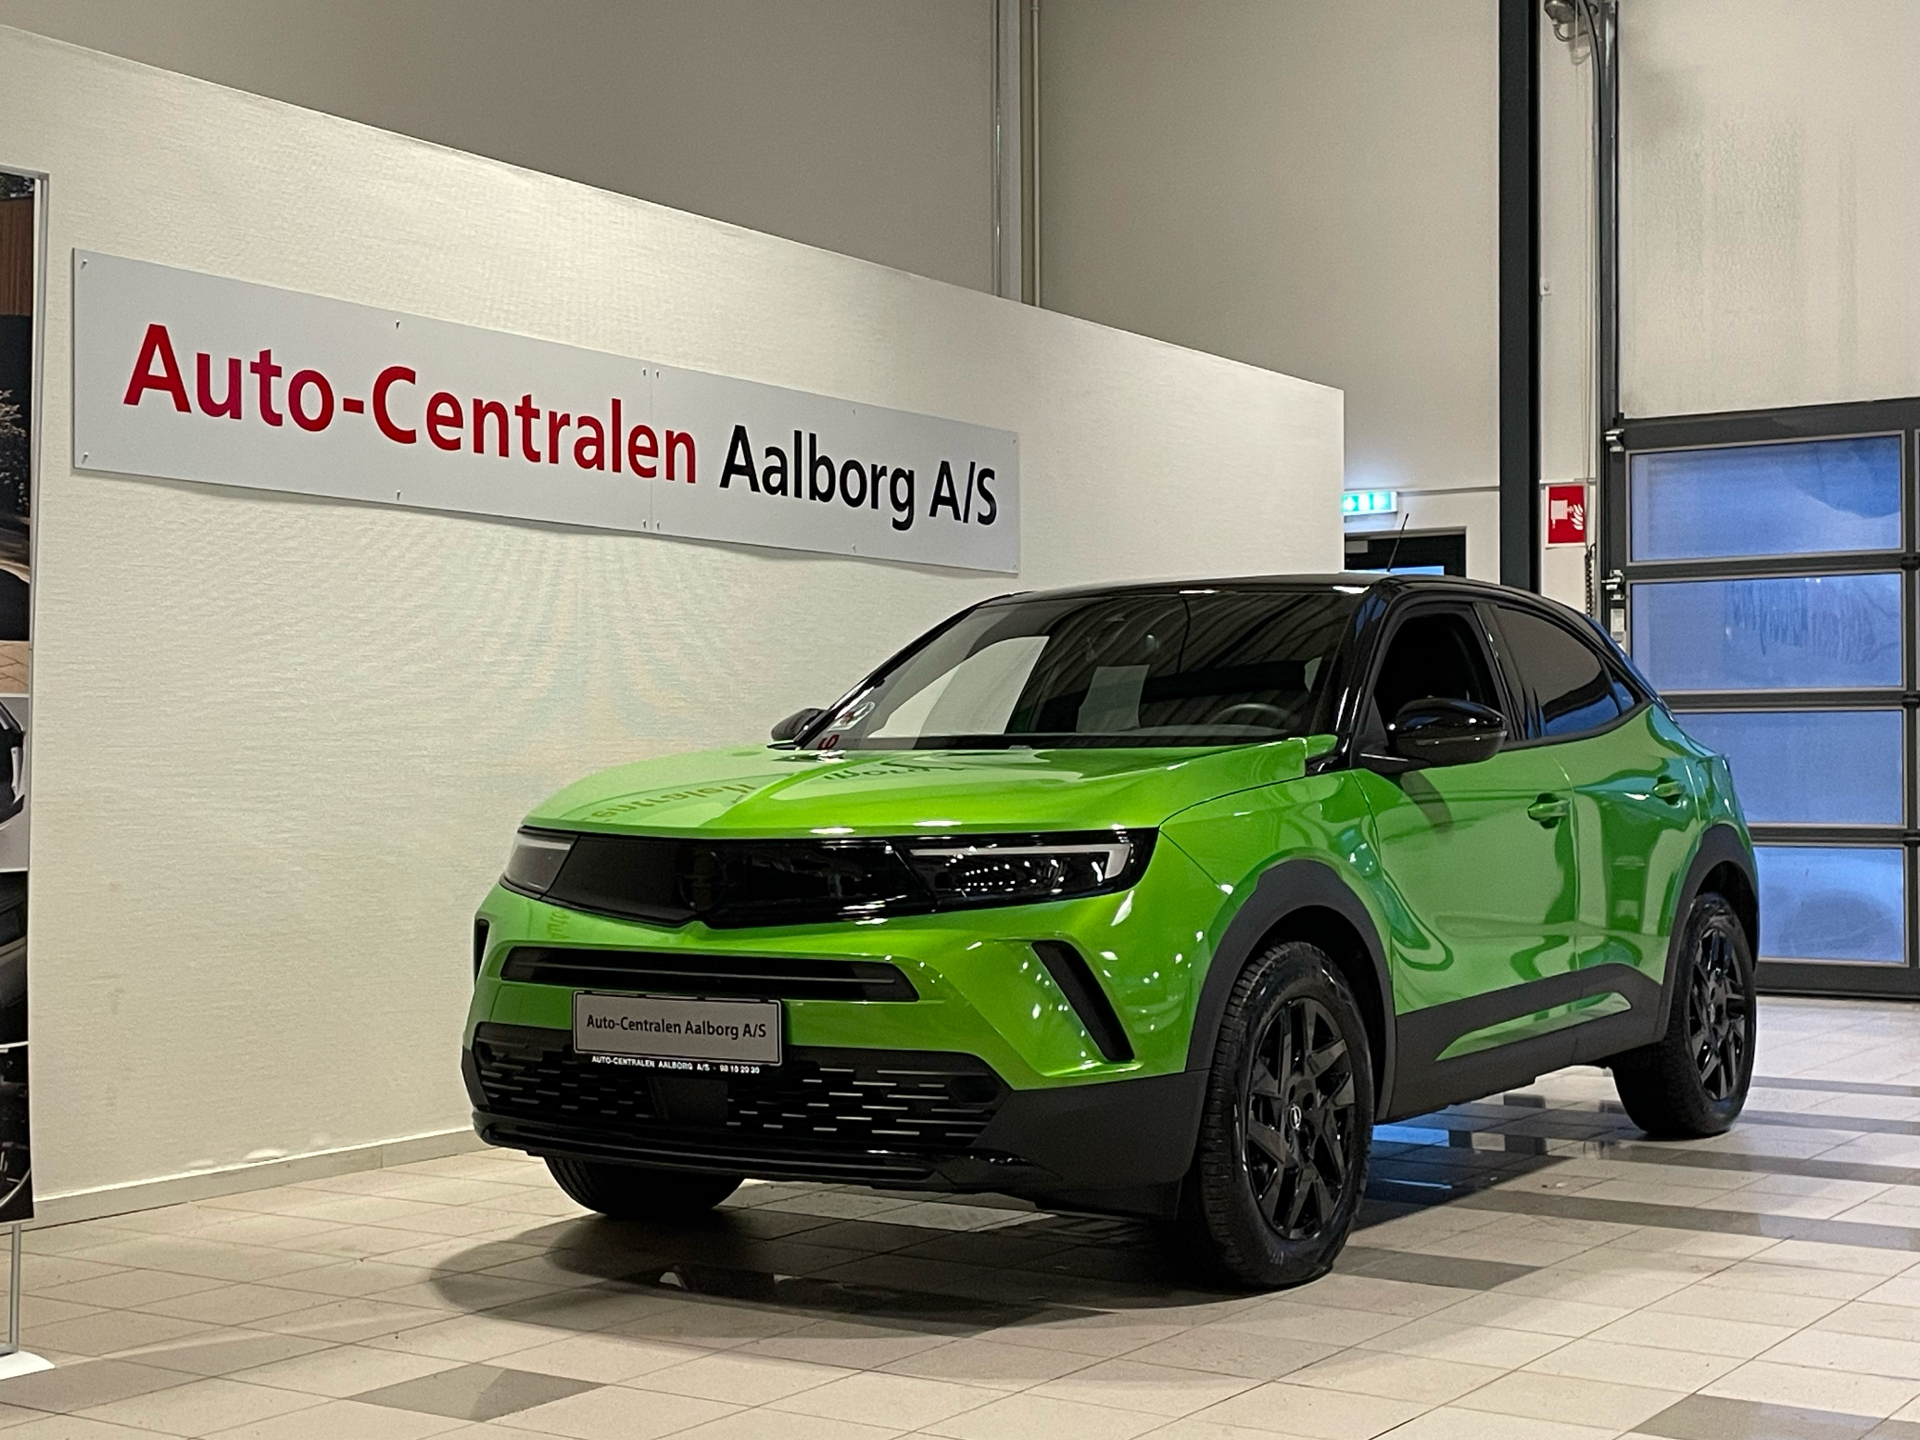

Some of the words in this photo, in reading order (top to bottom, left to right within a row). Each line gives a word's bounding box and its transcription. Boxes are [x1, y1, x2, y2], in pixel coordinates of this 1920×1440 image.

[123, 322, 697, 484] Auto-Centralen
[719, 424, 915, 531] Aalborg
[928, 460, 998, 526] A/S
[586, 1014, 682, 1035] Auto-Centralen
[684, 1020, 739, 1040] Aalborg
[742, 1023, 767, 1038] A/S
[591, 1055, 656, 1068] AUTO-CENTRALEN
[658, 1060, 694, 1071] AALBORG
[696, 1063, 711, 1072] A/S
[740, 1065, 750, 1074] 20
